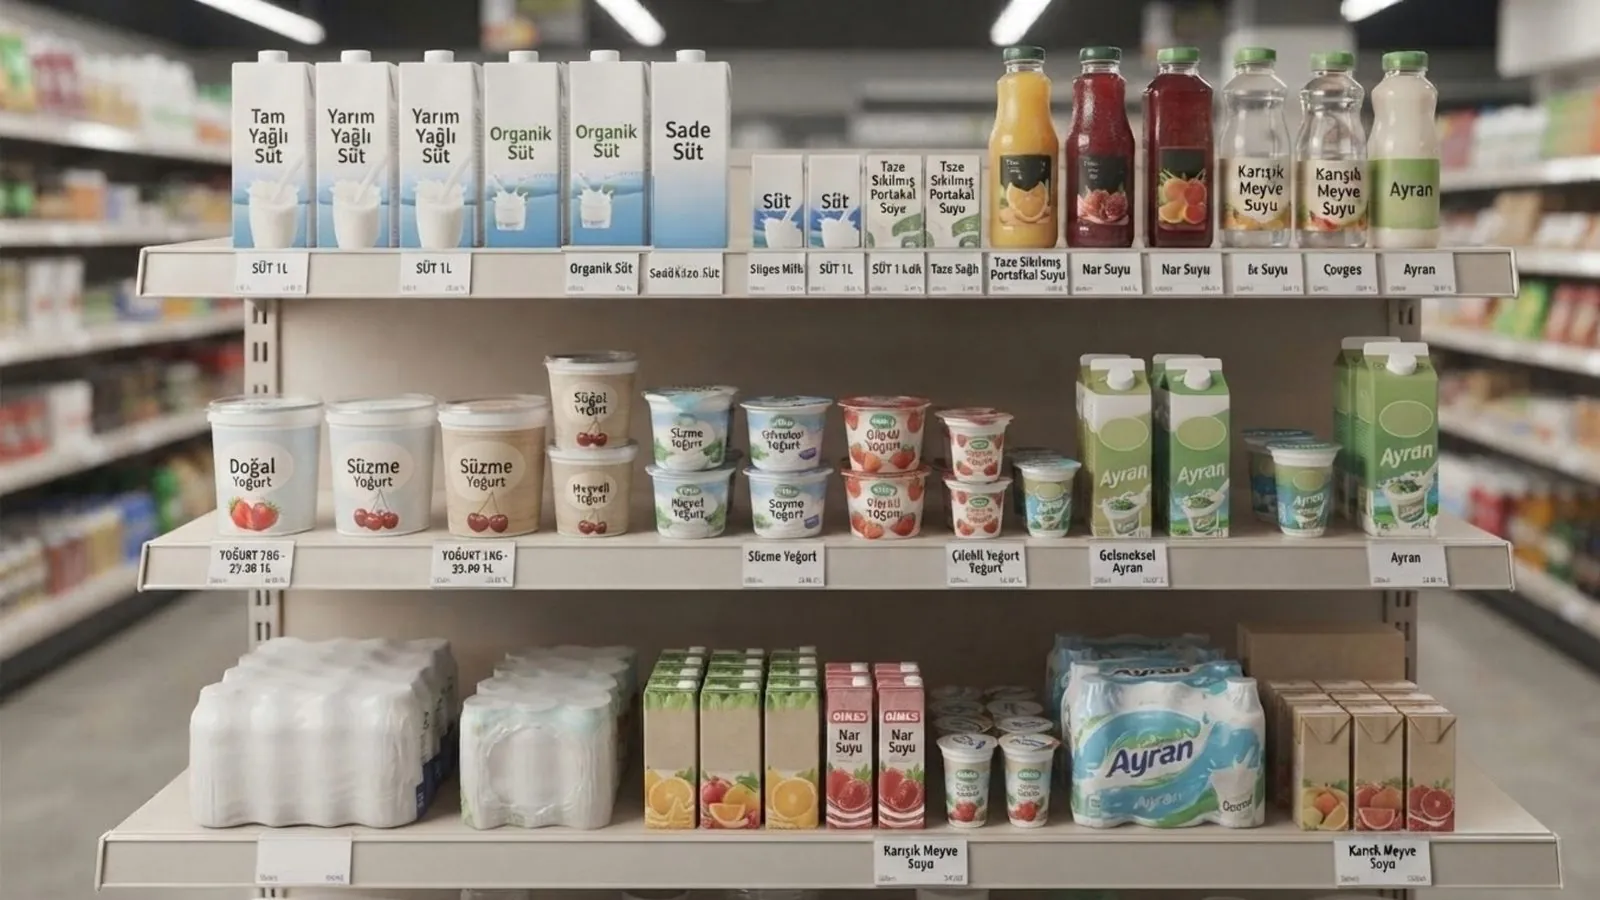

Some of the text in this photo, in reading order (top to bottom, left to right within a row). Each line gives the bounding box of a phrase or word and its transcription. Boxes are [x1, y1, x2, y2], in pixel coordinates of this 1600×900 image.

[251, 109, 285, 124] Tam
[328, 109, 374, 124] Yarım
[412, 109, 459, 124] Yarım
[490, 126, 552, 144] Organik
[576, 124, 637, 142] Organik
[666, 121, 710, 138] Sade
[250, 128, 288, 148] Yağlı
[332, 128, 371, 147] Yağlı
[416, 128, 456, 147] Yağlı
[255, 149, 283, 164] Süt
[338, 148, 365, 164] Süt
[423, 148, 450, 164] Süt
[508, 145, 534, 160] Süt
[593, 143, 620, 158] Süt
[673, 142, 703, 160] Süt
[881, 161, 905, 172] Taze
[871, 189, 916, 200] Portakal
[930, 189, 974, 200] Portakal
[1240, 182, 1283, 198] Meyve
[1318, 185, 1360, 201] Meyve
[1390, 182, 1433, 200] Ayran
[763, 193, 791, 209] Süt
[1244, 200, 1277, 215] Suyu
[940, 204, 965, 216] Suyu
[1323, 202, 1355, 218] Suyu
[252, 260, 273, 274] SÜT
[416, 260, 437, 274] SÜT
[570, 263, 612, 276] Organik
[820, 263, 839, 274] SÜT
[872, 263, 892, 274] SÜT
[931, 265, 952, 274] Taze
[994, 257, 1017, 268] Taze
[1040, 269, 1066, 282] Suyu
[1083, 264, 1130, 277] Nar Suyu
[1162, 264, 1210, 277] Nar Suyu
[1261, 264, 1288, 277] Suyu
[1404, 264, 1435, 277] Ayran
[1380, 444, 1433, 468] Ayran
[230, 458, 275, 478] Doğal
[347, 458, 399, 474] Süzme
[460, 459, 512, 473] Süzme
[1100, 465, 1148, 488] Ayran
[1177, 462, 1225, 486] Ayran
[1391, 552, 1420, 565] Ayran
[1112, 563, 1143, 575] Ayran
[839, 729, 860, 740] Nar
[891, 729, 913, 740] Nar
[836, 742, 862, 755] Suyu
[1106, 739, 1193, 778] Ayran
[923, 845, 958, 859] Meyve
[1384, 845, 1416, 860] Meyve
